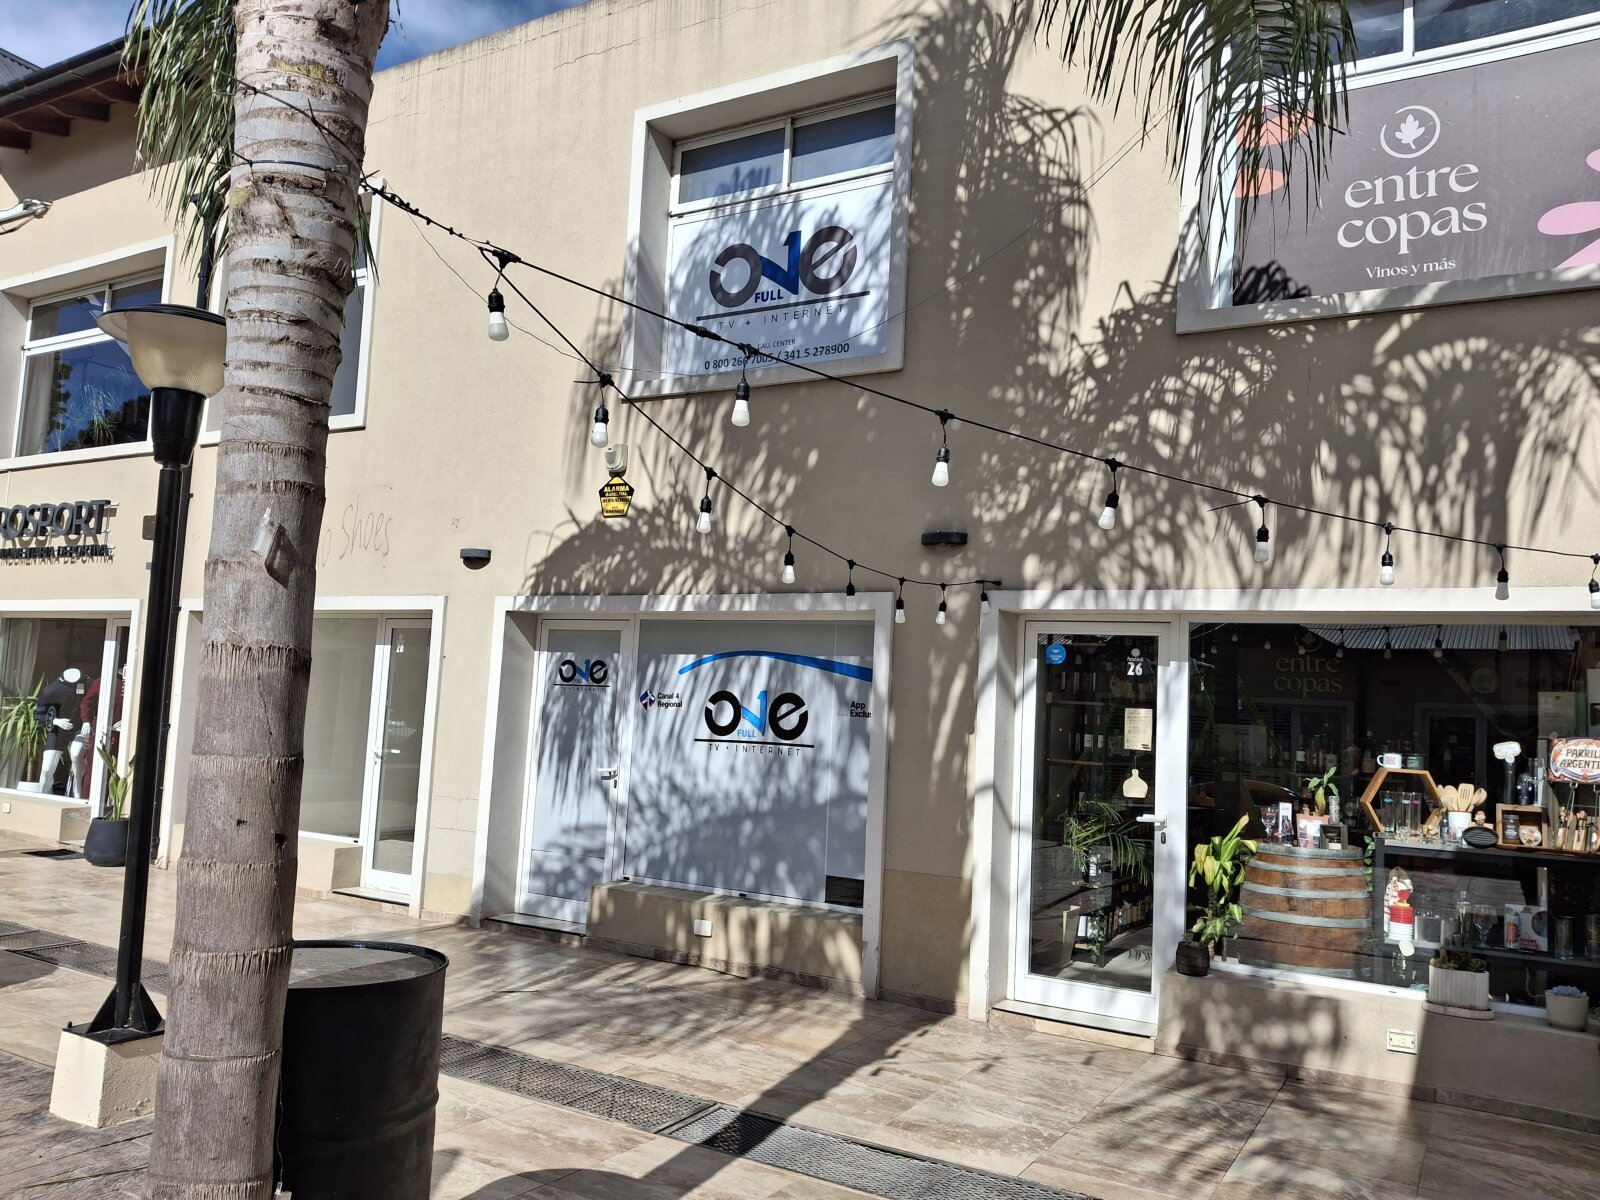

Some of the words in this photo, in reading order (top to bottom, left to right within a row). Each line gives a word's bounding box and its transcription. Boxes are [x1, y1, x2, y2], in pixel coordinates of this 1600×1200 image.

[1344, 163, 1480, 209] entre
[1336, 202, 1488, 255] copas
[1366, 264, 1408, 279] Vinos
[1409, 262, 1421, 277] y
[1423, 257, 1456, 273] más
[753, 288, 784, 304] FULL
[718, 320, 735, 331] TV
[763, 303, 845, 325] INTERNET
[772, 338, 796, 348] CENTER
[704, 360, 711, 370] 0
[712, 359, 729, 369] 800
[784, 350, 802, 361] 341
[804, 348, 810, 358] 5
[813, 342, 850, 356] 278900
[603, 485, 630, 493] ALARMA
[1127, 662, 1143, 676] 26
[1275, 655, 1340, 673] entre
[1273, 676, 1343, 699] copas
[657, 692, 674, 700] Canal
[674, 692, 680, 700] 4
[657, 700, 683, 708] Regional
[850, 700, 866, 710] App
[736, 729, 757, 738] FULL
[708, 743, 720, 752] TV
[735, 744, 801, 756] INTERNET
